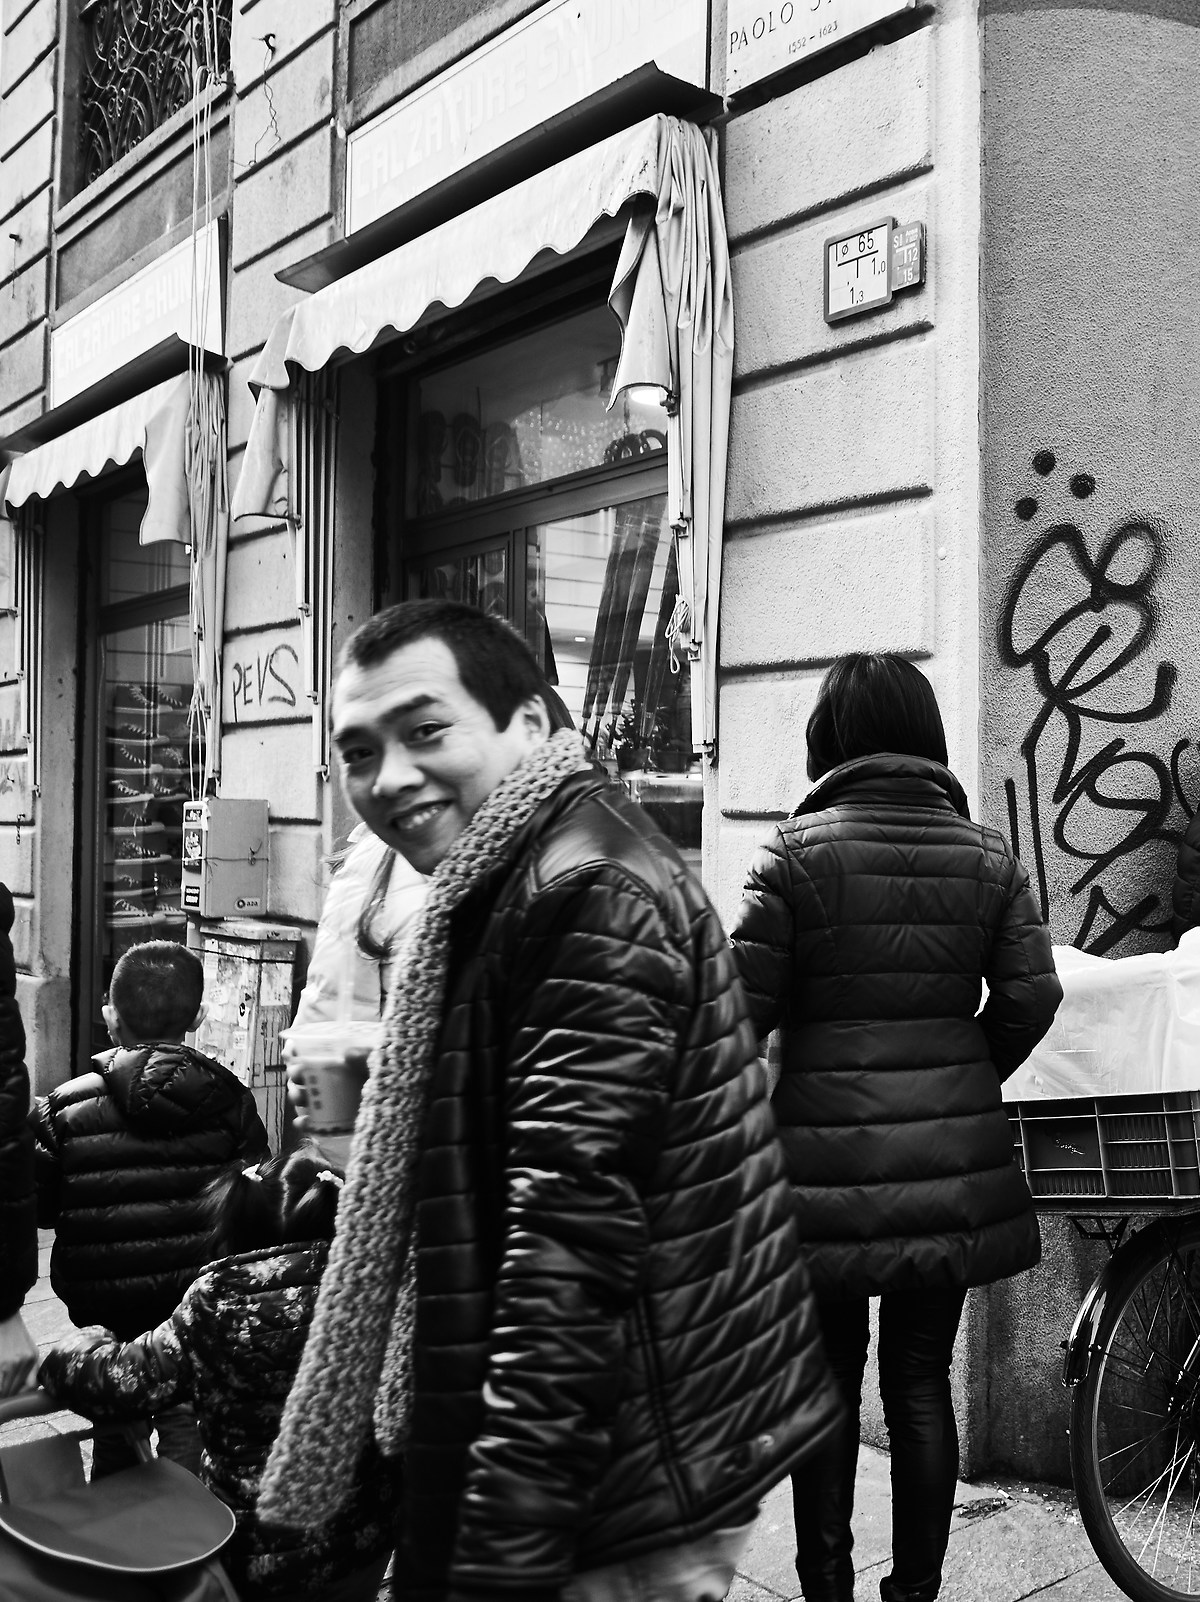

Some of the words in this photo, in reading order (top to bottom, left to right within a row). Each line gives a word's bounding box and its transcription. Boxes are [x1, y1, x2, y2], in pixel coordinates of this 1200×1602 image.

[729, 1, 794, 54] PAOLO
[354, 46, 529, 202] CALZATURE
[858, 230, 874, 253] 65
[871, 257, 886, 275] 1,0
[849, 286, 864, 304] 1,3
[56, 292, 141, 379] CALZATURE
